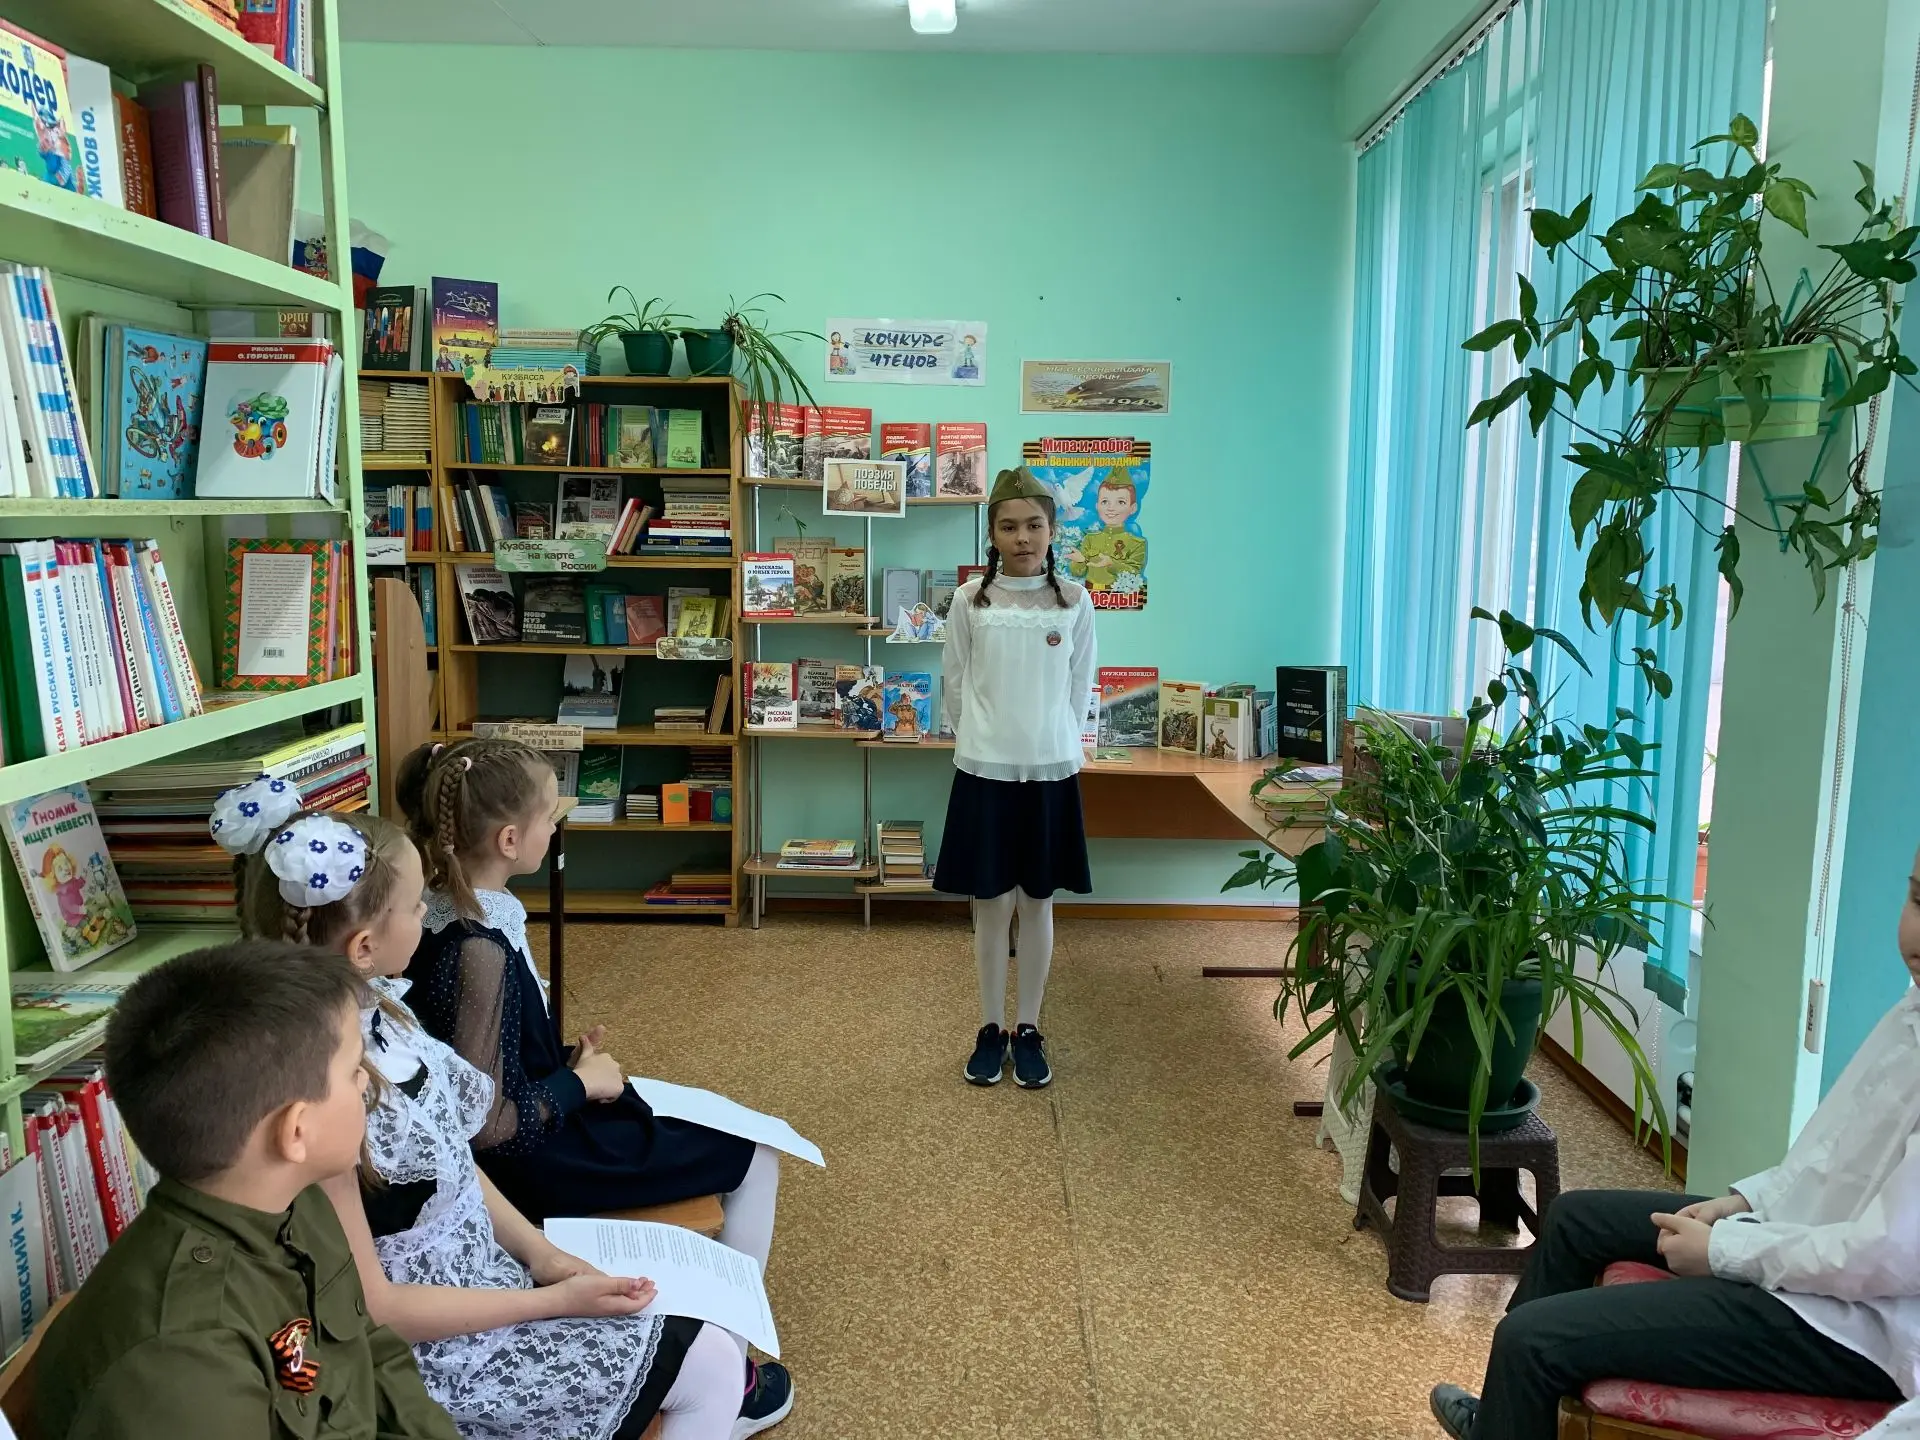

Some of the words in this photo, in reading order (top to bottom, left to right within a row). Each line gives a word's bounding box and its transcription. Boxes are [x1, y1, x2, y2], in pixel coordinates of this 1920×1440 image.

[0, 59, 58, 112] кодер
[84, 135, 103, 198] ЖКОВ
[864, 331, 944, 348] КОНКУРС
[501, 373, 545, 381] КУЗБАССА
[870, 353, 938, 368] ЧТЕЦОВ
[325, 406, 336, 493] МИХАЛКОВ
[1042, 438, 1076, 453] Мира
[1079, 441, 1090, 452] и
[1091, 437, 1132, 453] добра
[1050, 456, 1091, 467] Великий
[854, 468, 894, 481] ПОЭЗИЯ
[854, 479, 897, 491] ПОБЕДЫ
[499, 542, 543, 552] Кузбасс
[527, 552, 540, 560] на
[544, 552, 574, 561] карте
[561, 562, 597, 571] России
[160, 581, 181, 634] ПИСАТЕЛЕЙ
[1090, 591, 1139, 608] беды!
[35, 587, 52, 657] ПИСАТЕЛЕЙ
[54, 585, 71, 653] ПИСАТЕЛЕЙ
[45, 659, 61, 714] РУССКИХ
[64, 657, 80, 709] РУССКИХ
[53, 716, 67, 752] КАЗКИ
[73, 711, 85, 746] КАЗКИ
[773, 715, 793, 723] ВОЙНЕ
[23, 828, 52, 846] ИЩЕТ
[56, 812, 93, 835] НЕВЕСТУ
[50, 1132, 66, 1190] ПИСАТЕЛЕЙ
[61, 1193, 76, 1238] РУССКИХ
[71, 1241, 85, 1283] ССКАЗЫ
[10, 1227, 33, 1339] КОВСКИЙ
